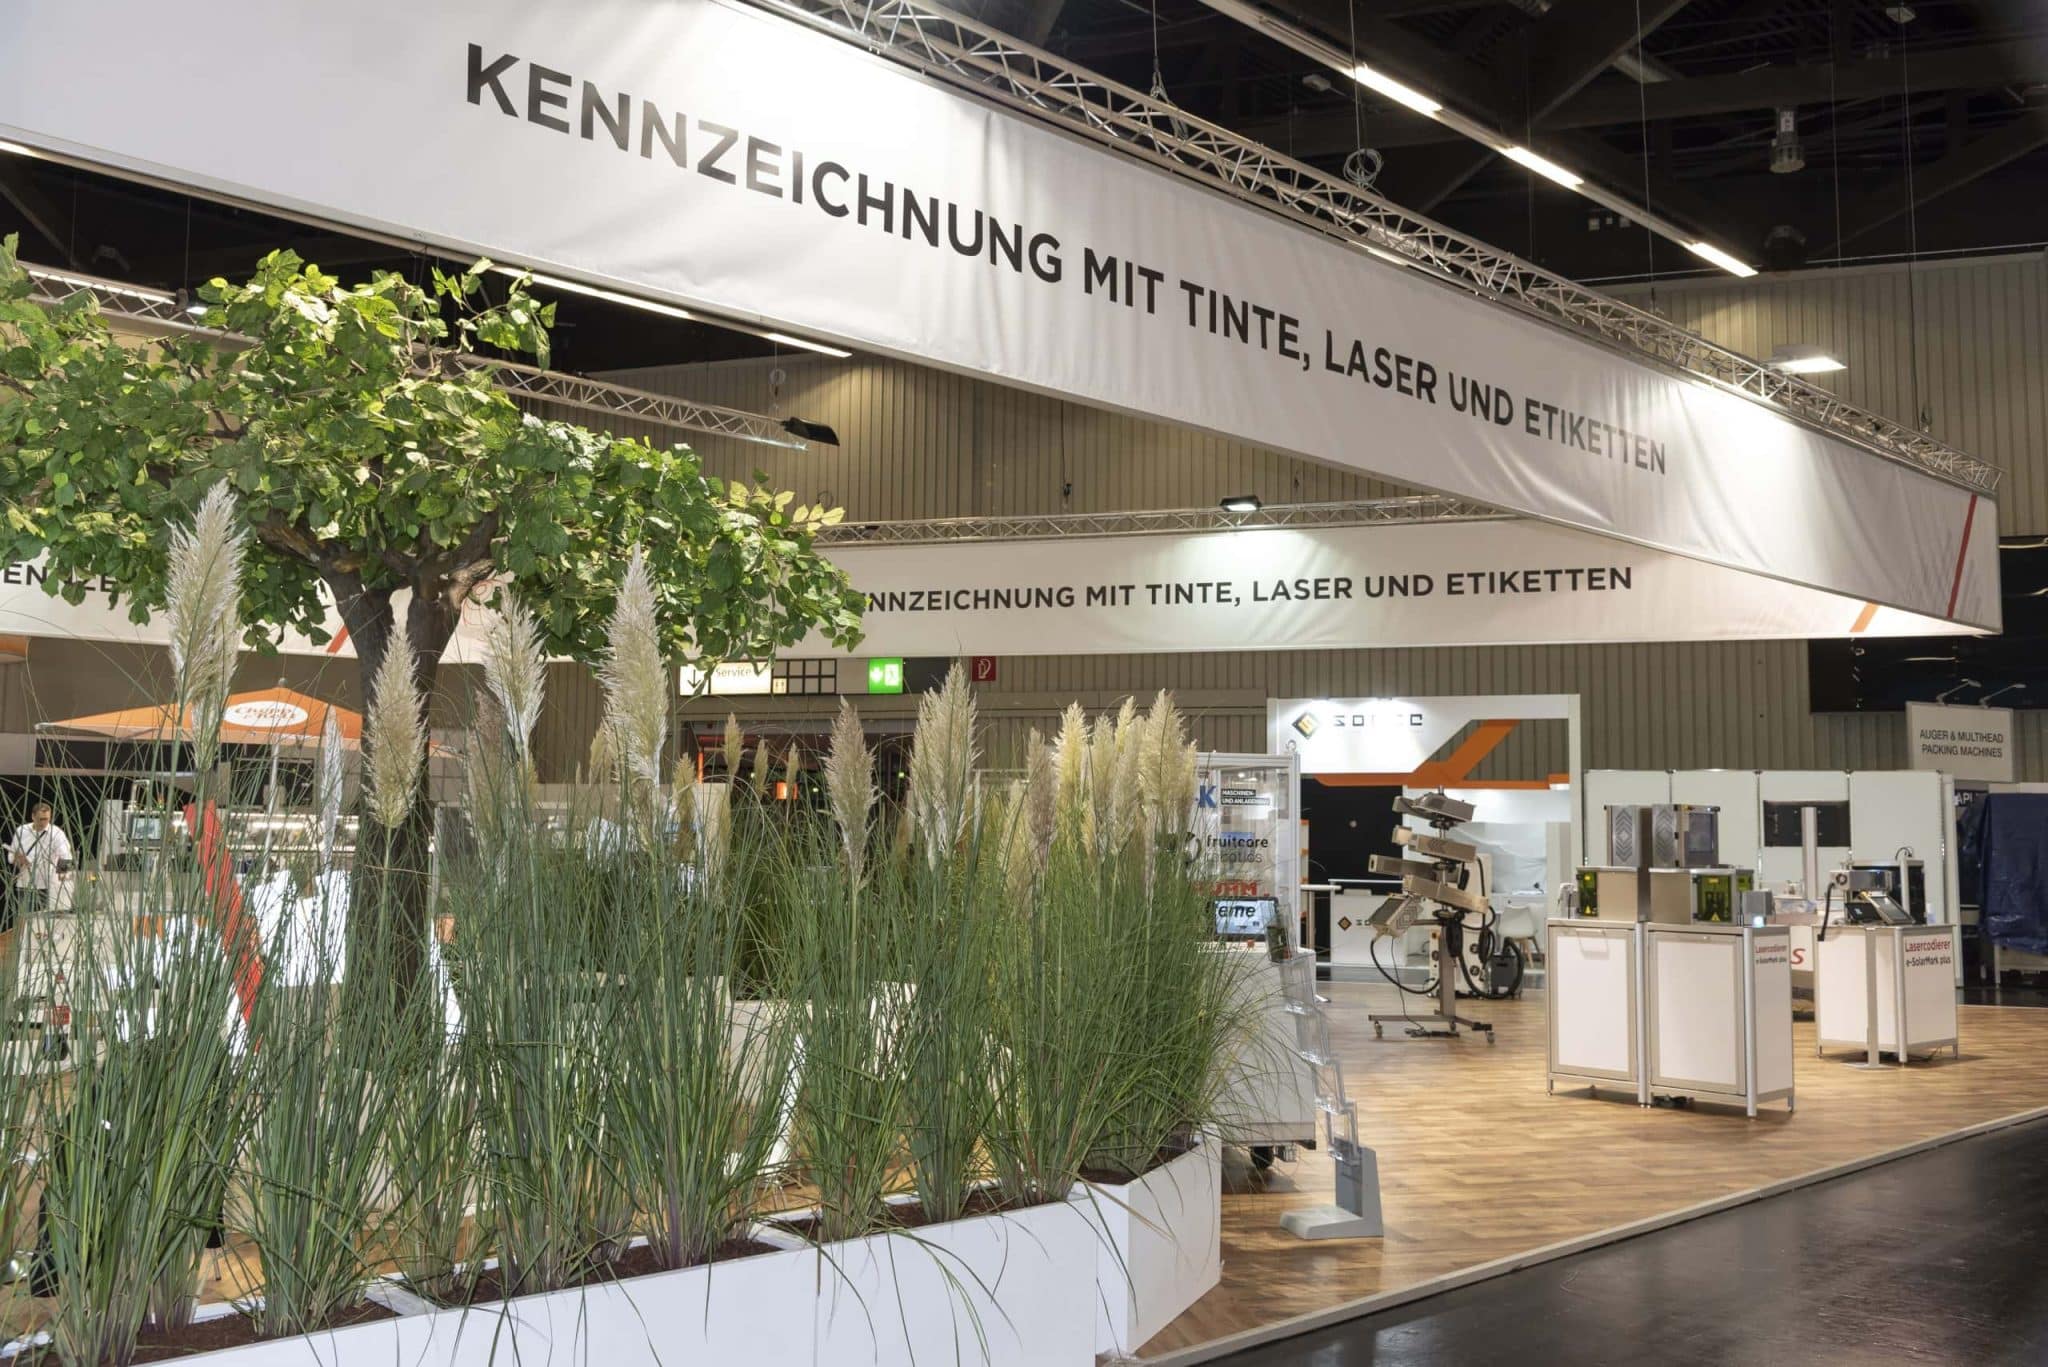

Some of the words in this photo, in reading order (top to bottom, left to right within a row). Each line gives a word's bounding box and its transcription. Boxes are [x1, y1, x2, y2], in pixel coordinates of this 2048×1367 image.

[467, 43, 1062, 283] KENNZEICHNUNG
[1084, 247, 1164, 315] MIT
[1179, 279, 1310, 371] TINTE,
[1325, 329, 1438, 404] LASER
[1448, 371, 1514, 426] UND
[1525, 397, 1666, 475] ETIKETTEN
[866, 586, 1075, 612] NNZEICHNUNG
[1086, 585, 1136, 607] MIT
[1146, 582, 1241, 607] TINTE,
[1253, 577, 1353, 602] LASER
[1365, 574, 1434, 598] UND
[1446, 567, 1632, 595] ETIKETTEN
[1920, 729, 1949, 741] AUGER
[1958, 731, 2004, 744] MULTIHEAD
[1922, 743, 1959, 756] PACKING
[1960, 745, 2003, 758] MACHINES
[1207, 834, 1269, 848] fruitcore
